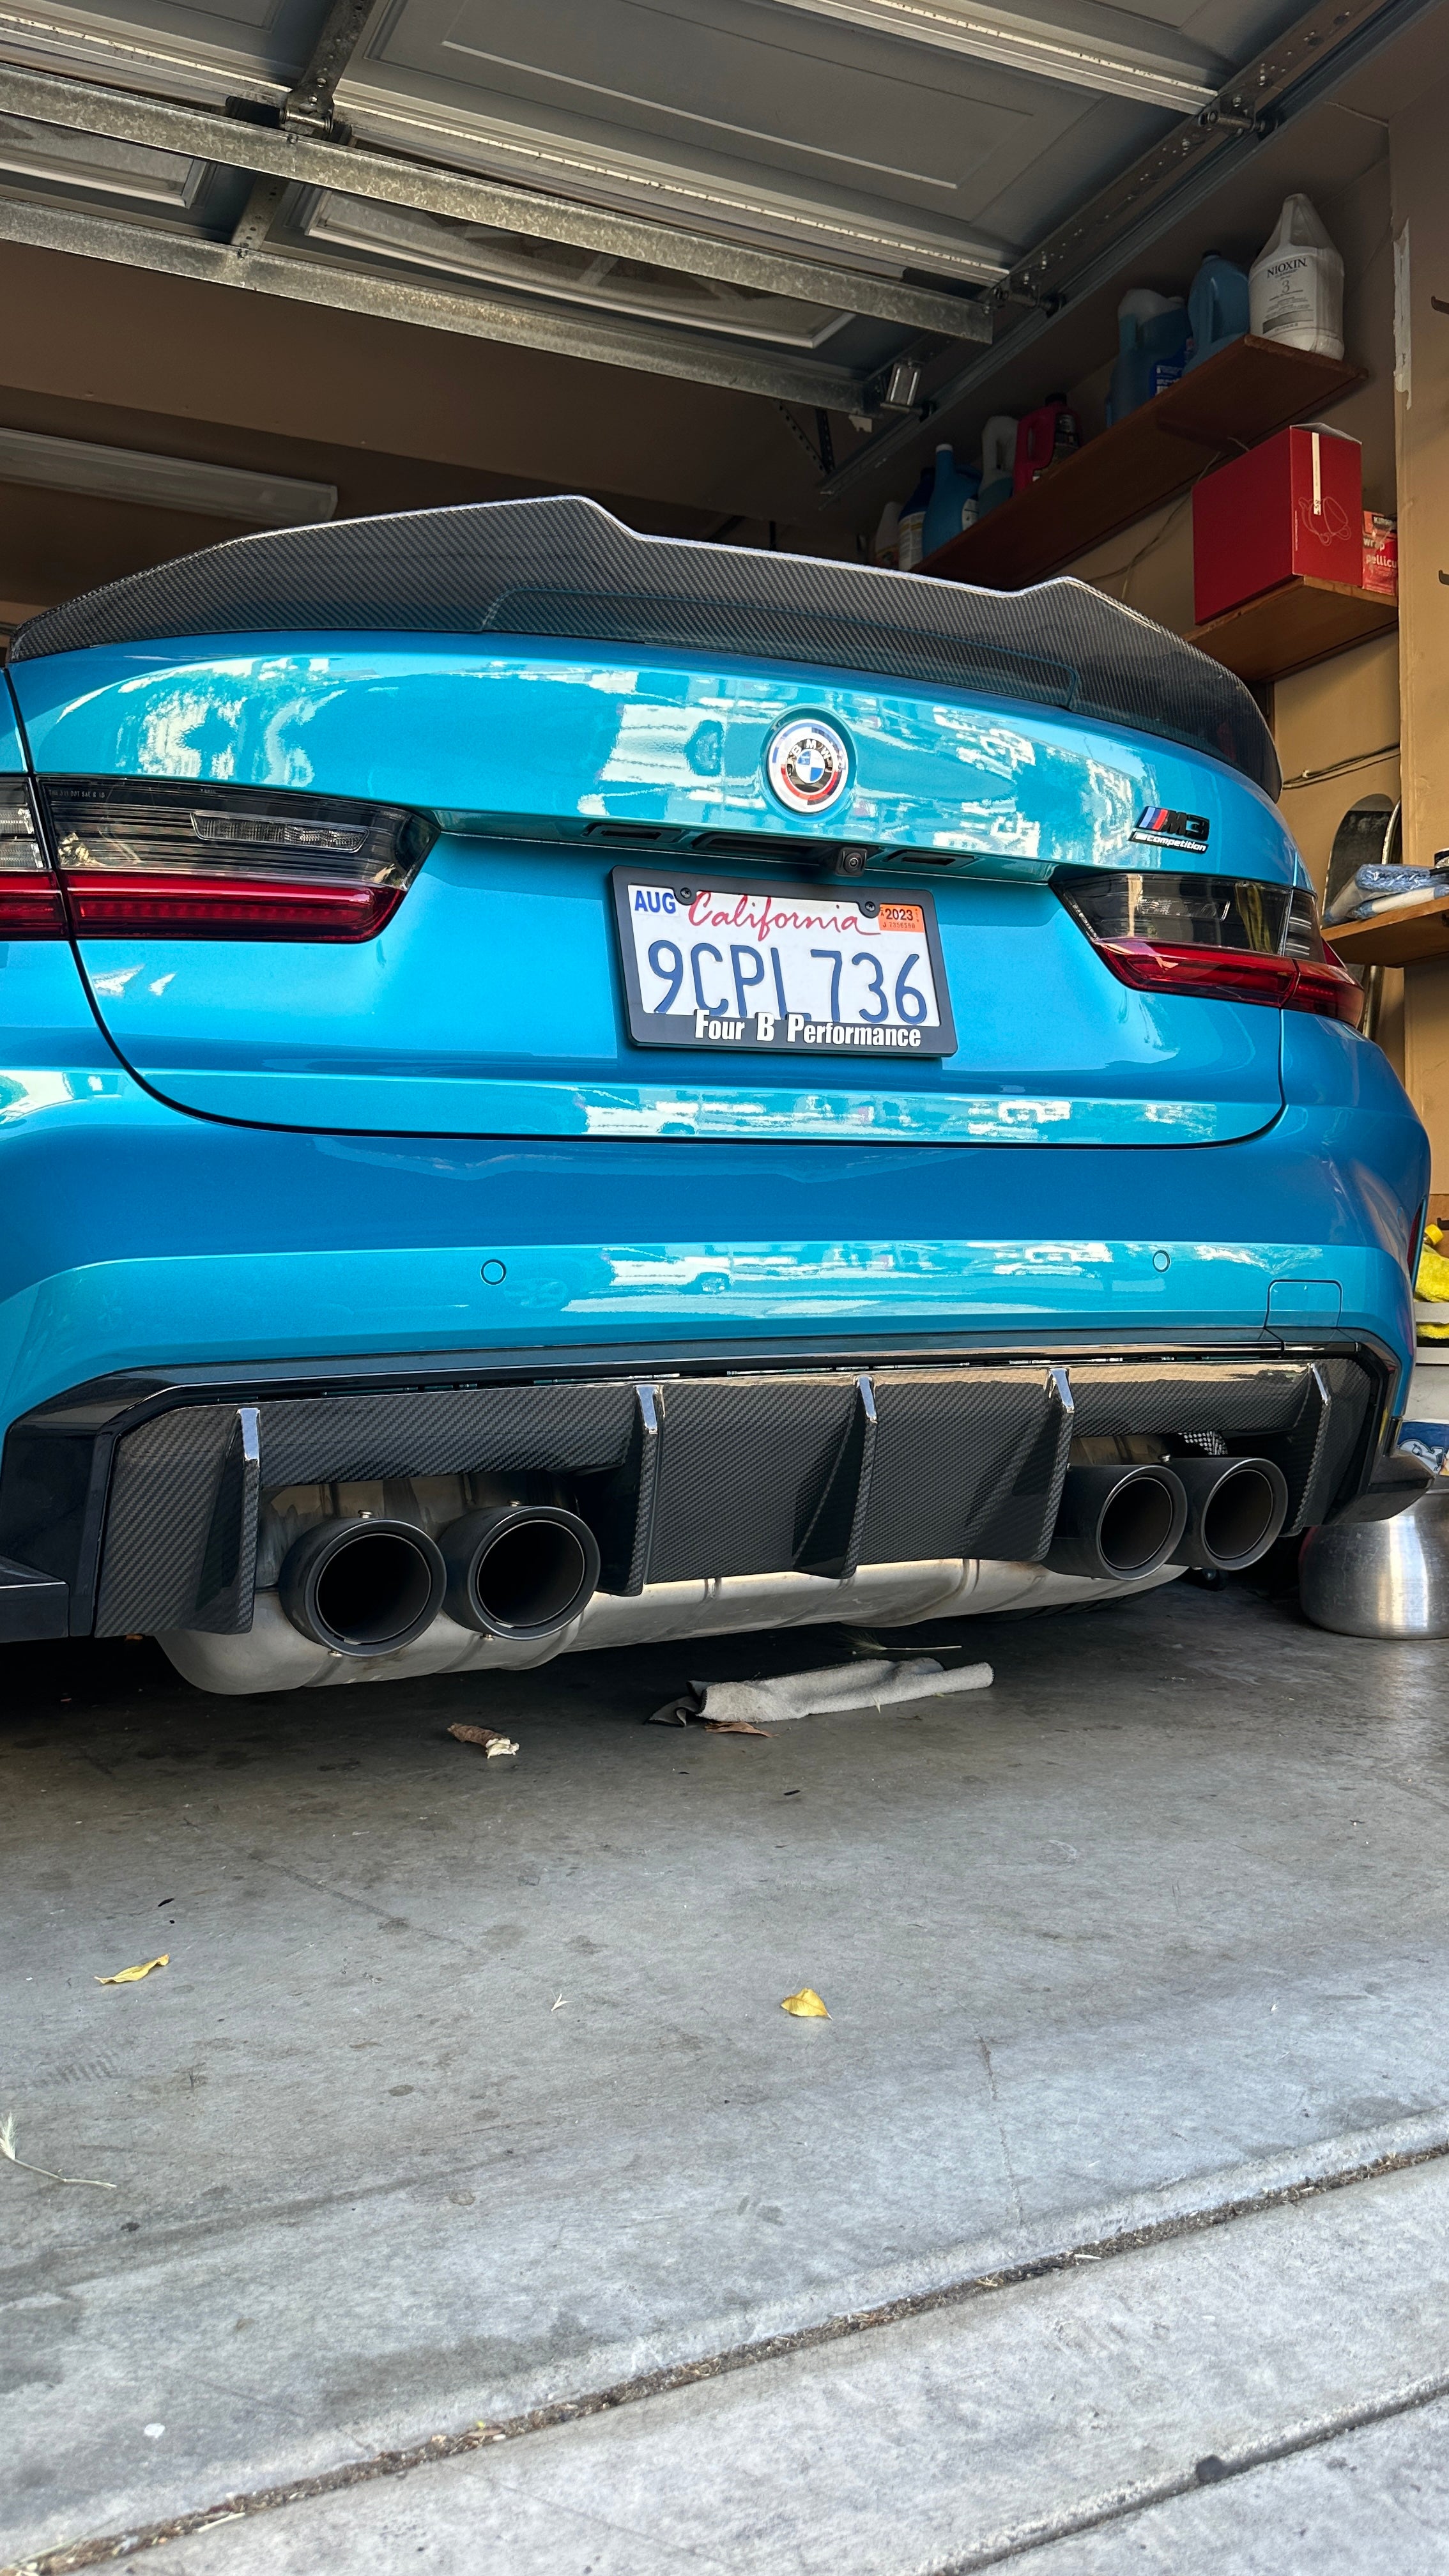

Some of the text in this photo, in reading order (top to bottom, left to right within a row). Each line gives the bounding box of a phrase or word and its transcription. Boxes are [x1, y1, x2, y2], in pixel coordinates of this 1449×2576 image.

[1267, 258, 1308, 279] NIOXIN
[1282, 280, 1290, 293] 3
[791, 739, 831, 760] BMW
[1160, 809, 1210, 841] M3
[1146, 834, 1207, 852] competition
[634, 890, 677, 914] AUG
[688, 891, 882, 941] California
[885, 908, 914, 921] 2023
[648, 940, 928, 1025] 9CPL736
[694, 1009, 921, 1047] Four B Performance
